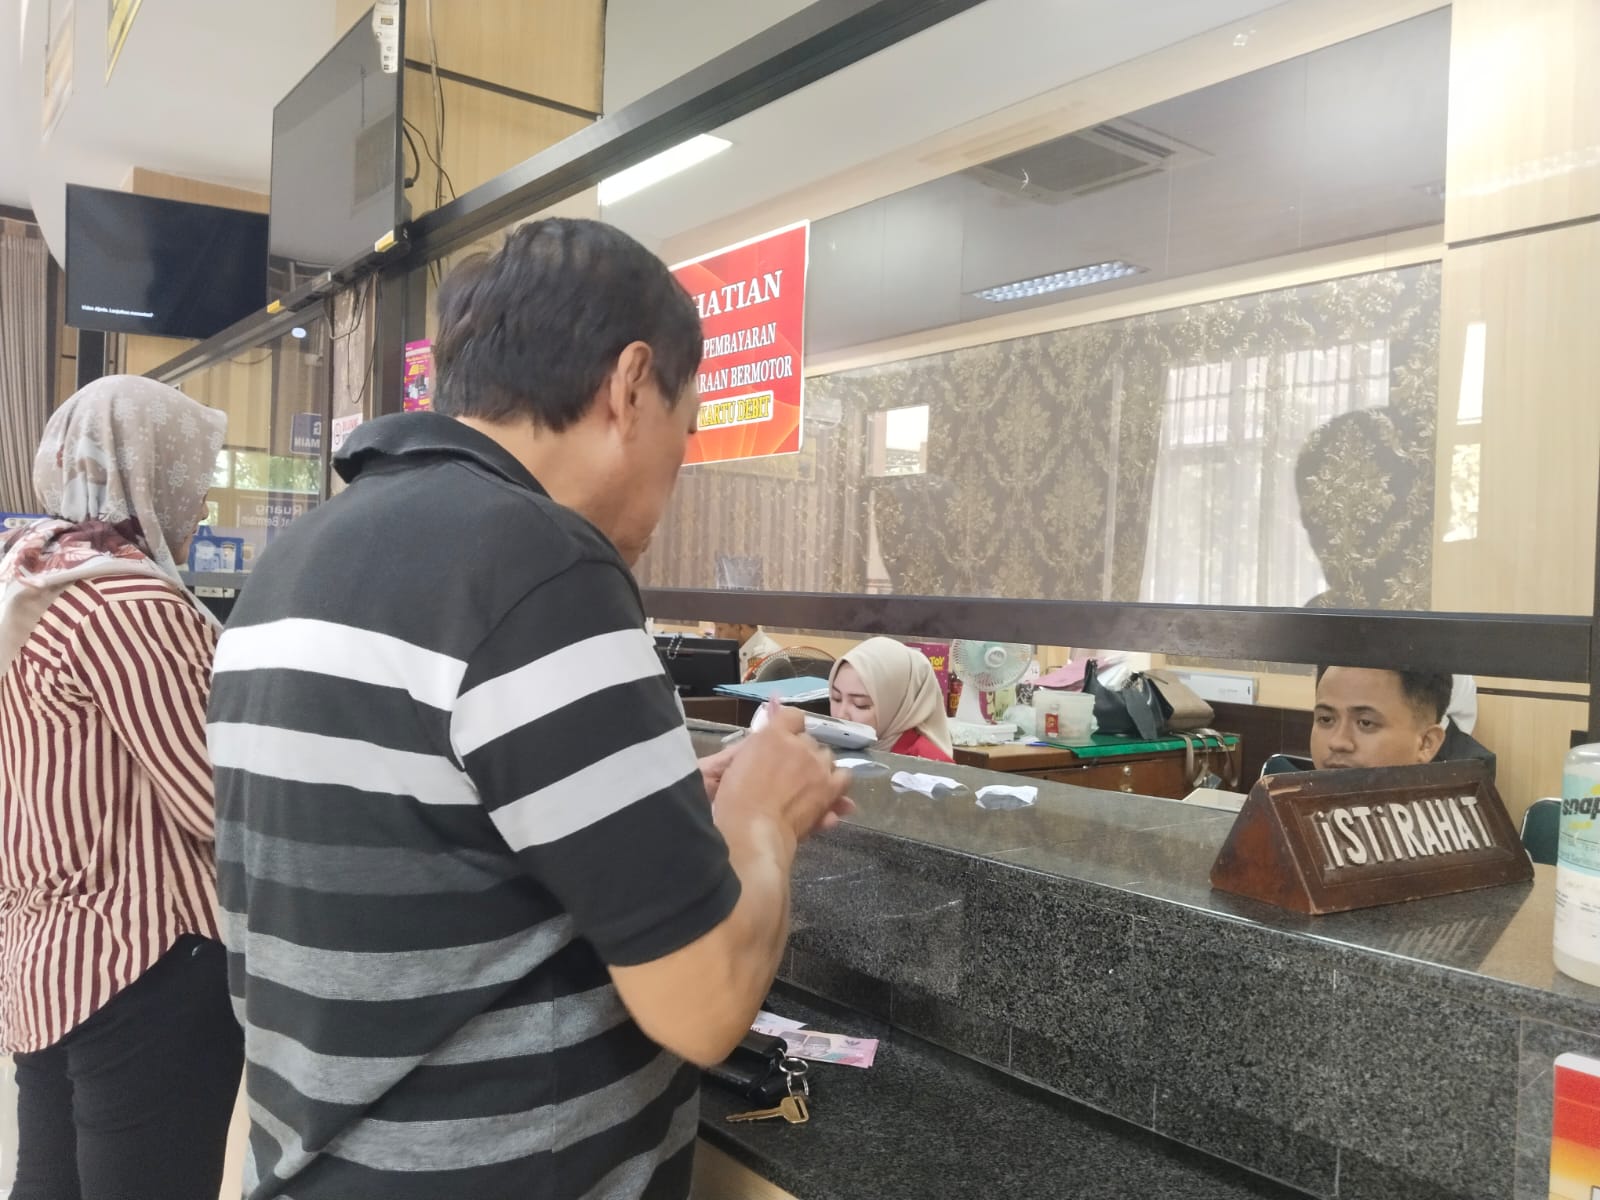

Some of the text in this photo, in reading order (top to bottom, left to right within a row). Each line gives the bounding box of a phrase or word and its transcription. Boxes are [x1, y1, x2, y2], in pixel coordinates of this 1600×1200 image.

[692, 269, 783, 319] HATIAN
[703, 322, 777, 360] PEMBAYARAN
[730, 355, 793, 388] BERMOTOR
[699, 395, 771, 427] KARTU DEBIT
